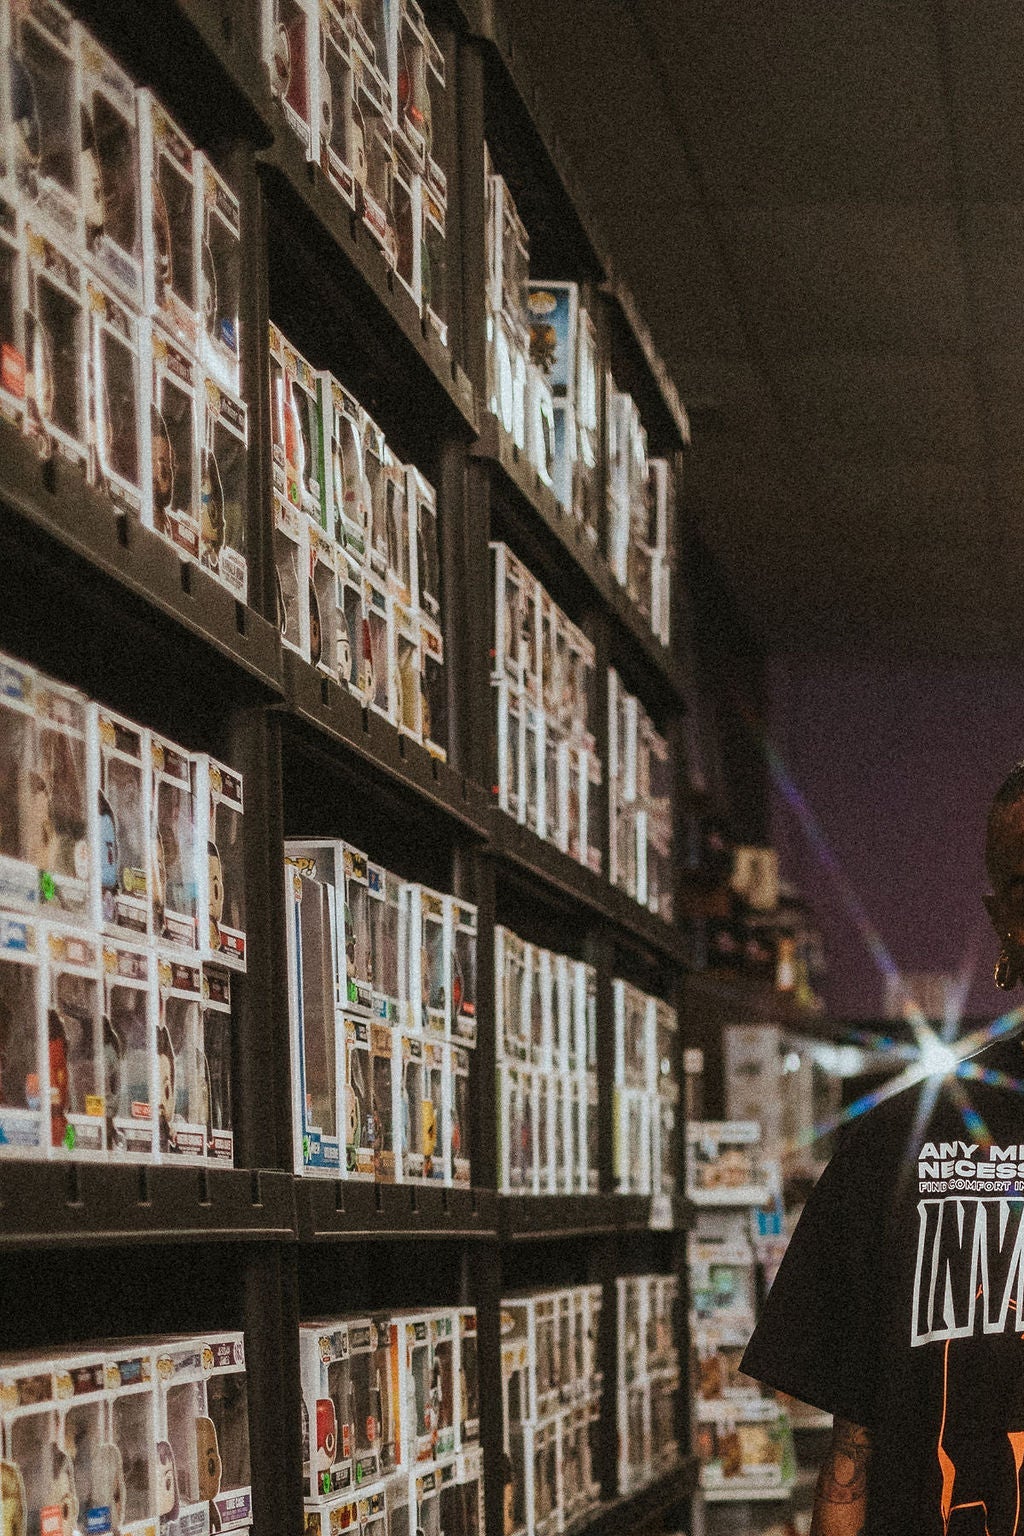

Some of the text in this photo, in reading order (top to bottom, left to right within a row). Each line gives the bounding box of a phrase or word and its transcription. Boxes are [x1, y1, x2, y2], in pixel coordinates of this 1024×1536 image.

[918, 1140, 980, 1160] ANY
[918, 1180, 948, 1193] FIND
[947, 1178, 1012, 1192] COMFORT
